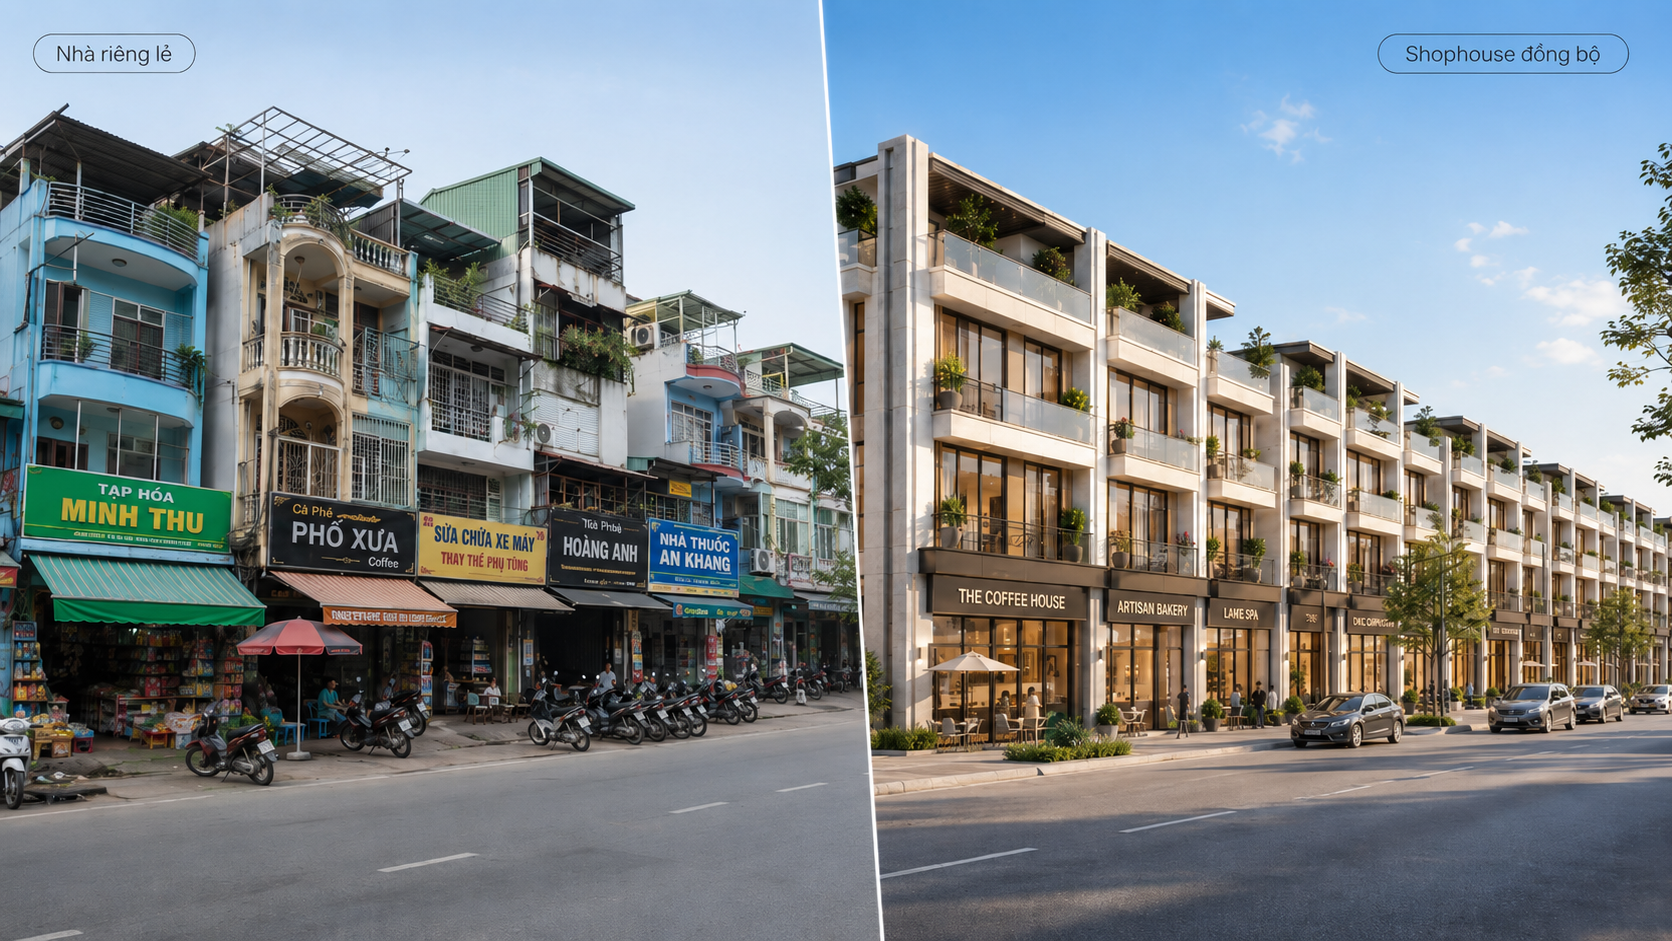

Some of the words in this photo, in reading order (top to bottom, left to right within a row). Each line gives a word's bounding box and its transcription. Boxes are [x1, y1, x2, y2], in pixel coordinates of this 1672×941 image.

[98, 483, 133, 500] TẠP
[138, 487, 175, 504] HÓA
[61, 497, 139, 528] MINH
[148, 506, 204, 534] THU
[291, 518, 344, 548] PHỐ
[350, 527, 399, 554] XƯA
[495, 533, 510, 550] XE
[512, 532, 535, 553] MÁY
[563, 534, 609, 560] HOÀNG
[612, 542, 638, 563] ANH
[368, 556, 399, 569] Coffee
[441, 551, 465, 566] THAY
[487, 556, 505, 573] PHỤ
[659, 549, 680, 567] AN
[685, 552, 731, 572] KHANG
[957, 588, 982, 604] THE
[985, 590, 1028, 607] COFFEE
[1030, 593, 1066, 610] HOUSE
[1117, 600, 1155, 615] ARTISAN
[1157, 602, 1188, 617] BAKERY
